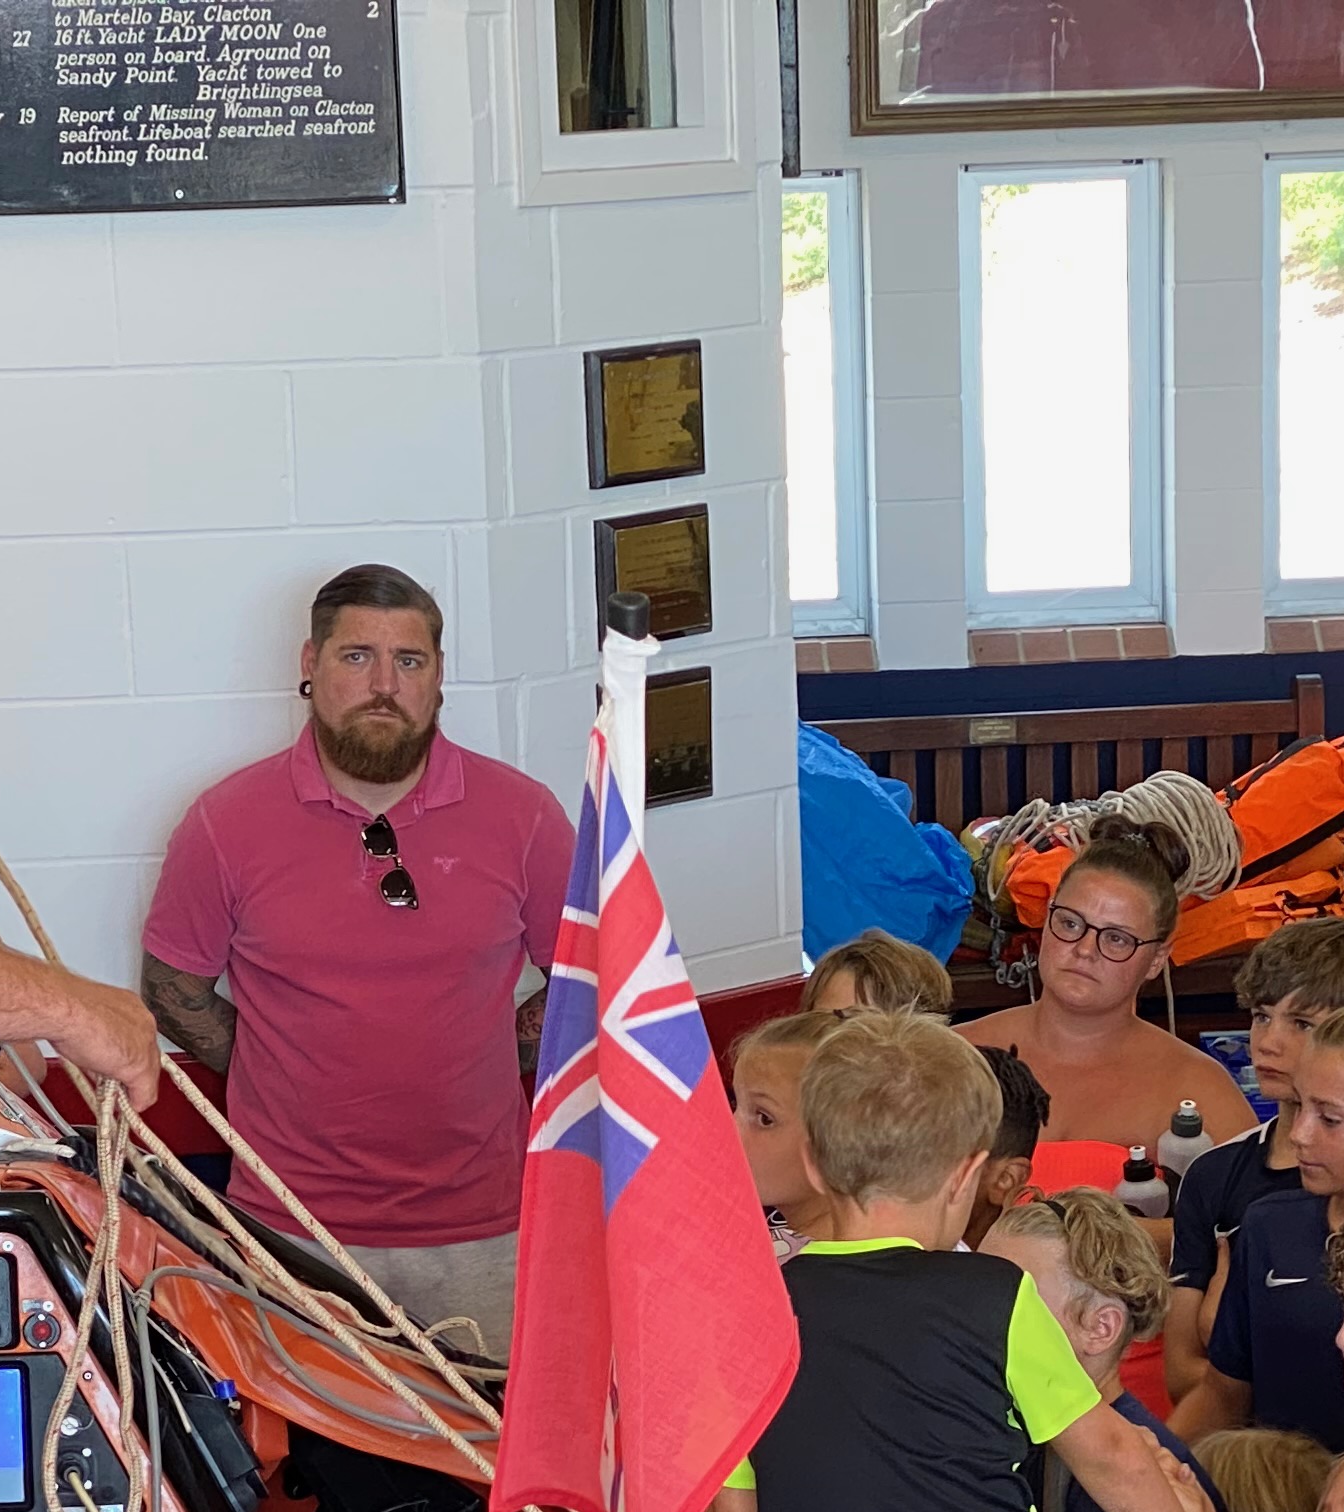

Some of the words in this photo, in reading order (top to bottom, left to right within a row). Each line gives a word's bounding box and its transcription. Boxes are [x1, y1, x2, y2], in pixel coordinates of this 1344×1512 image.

[55, 12, 72, 27] to
[76, 8, 152, 26] Martello
[203, 5, 272, 22] Clacton
[366, 1, 380, 18] 2
[12, 30, 32, 48] 27
[54, 30, 72, 46] 16
[98, 27, 146, 45] Yacht
[154, 25, 213, 43] LADY
[218, 23, 284, 42] MOON
[293, 23, 327, 39] One
[55, 51, 117, 70] person
[124, 50, 146, 65] on
[152, 44, 210, 64] board.
[215, 42, 302, 66] Aground
[307, 45, 331, 60] on
[56, 68, 117, 88] Sandy
[124, 67, 179, 84] Point.
[196, 64, 248, 82] Yacht
[256, 63, 313, 80] towed
[323, 63, 343, 78] to
[196, 84, 323, 103] Brightlingsea
[18, 108, 37, 125] 19
[57, 107, 115, 127] Report
[122, 105, 143, 122] of
[148, 102, 217, 122] Missing
[223, 101, 284, 119] Woman
[289, 104, 309, 117] on
[314, 100, 375, 117] Clacton
[58, 125, 133, 144] seafront.
[136, 121, 212, 142] Lifeboat
[217, 119, 296, 139] searched
[303, 117, 376, 137] seafront
[61, 144, 138, 167] nothing
[145, 142, 209, 163] found.
